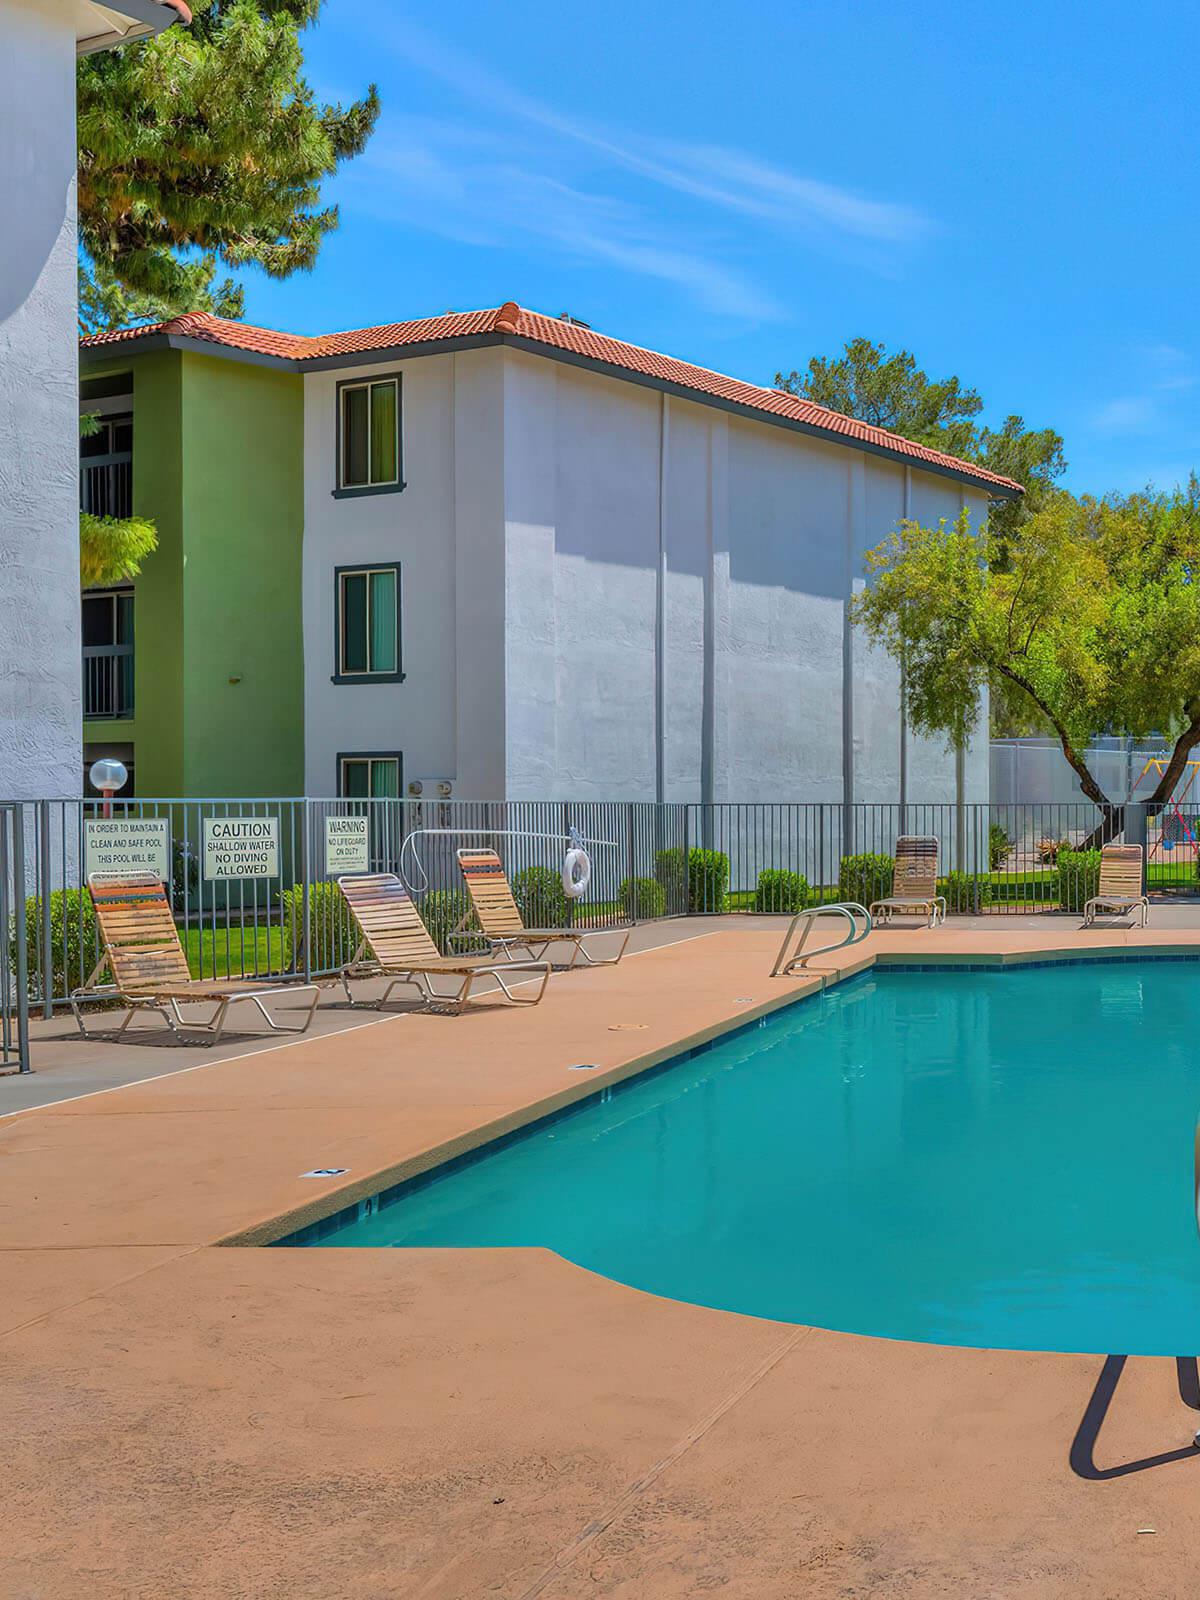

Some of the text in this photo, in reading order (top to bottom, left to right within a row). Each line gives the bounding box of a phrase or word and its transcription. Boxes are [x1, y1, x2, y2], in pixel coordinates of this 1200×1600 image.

[88, 824, 164, 833] IN ORDER TO MAINTAIN A
[212, 823, 271, 837] CAUTION
[329, 820, 365, 833] WARNING
[91, 838, 162, 848] CLEAN AND SAFE POOL
[207, 840, 275, 852] SHALLOW WATER
[328, 837, 366, 846] NO LIFEGUARD
[336, 847, 358, 855] ON DUTY
[98, 853, 156, 863] THIS POOL WILL BE
[215, 852, 268, 863] NO DIVING
[216, 864, 267, 875] ALLOWED
